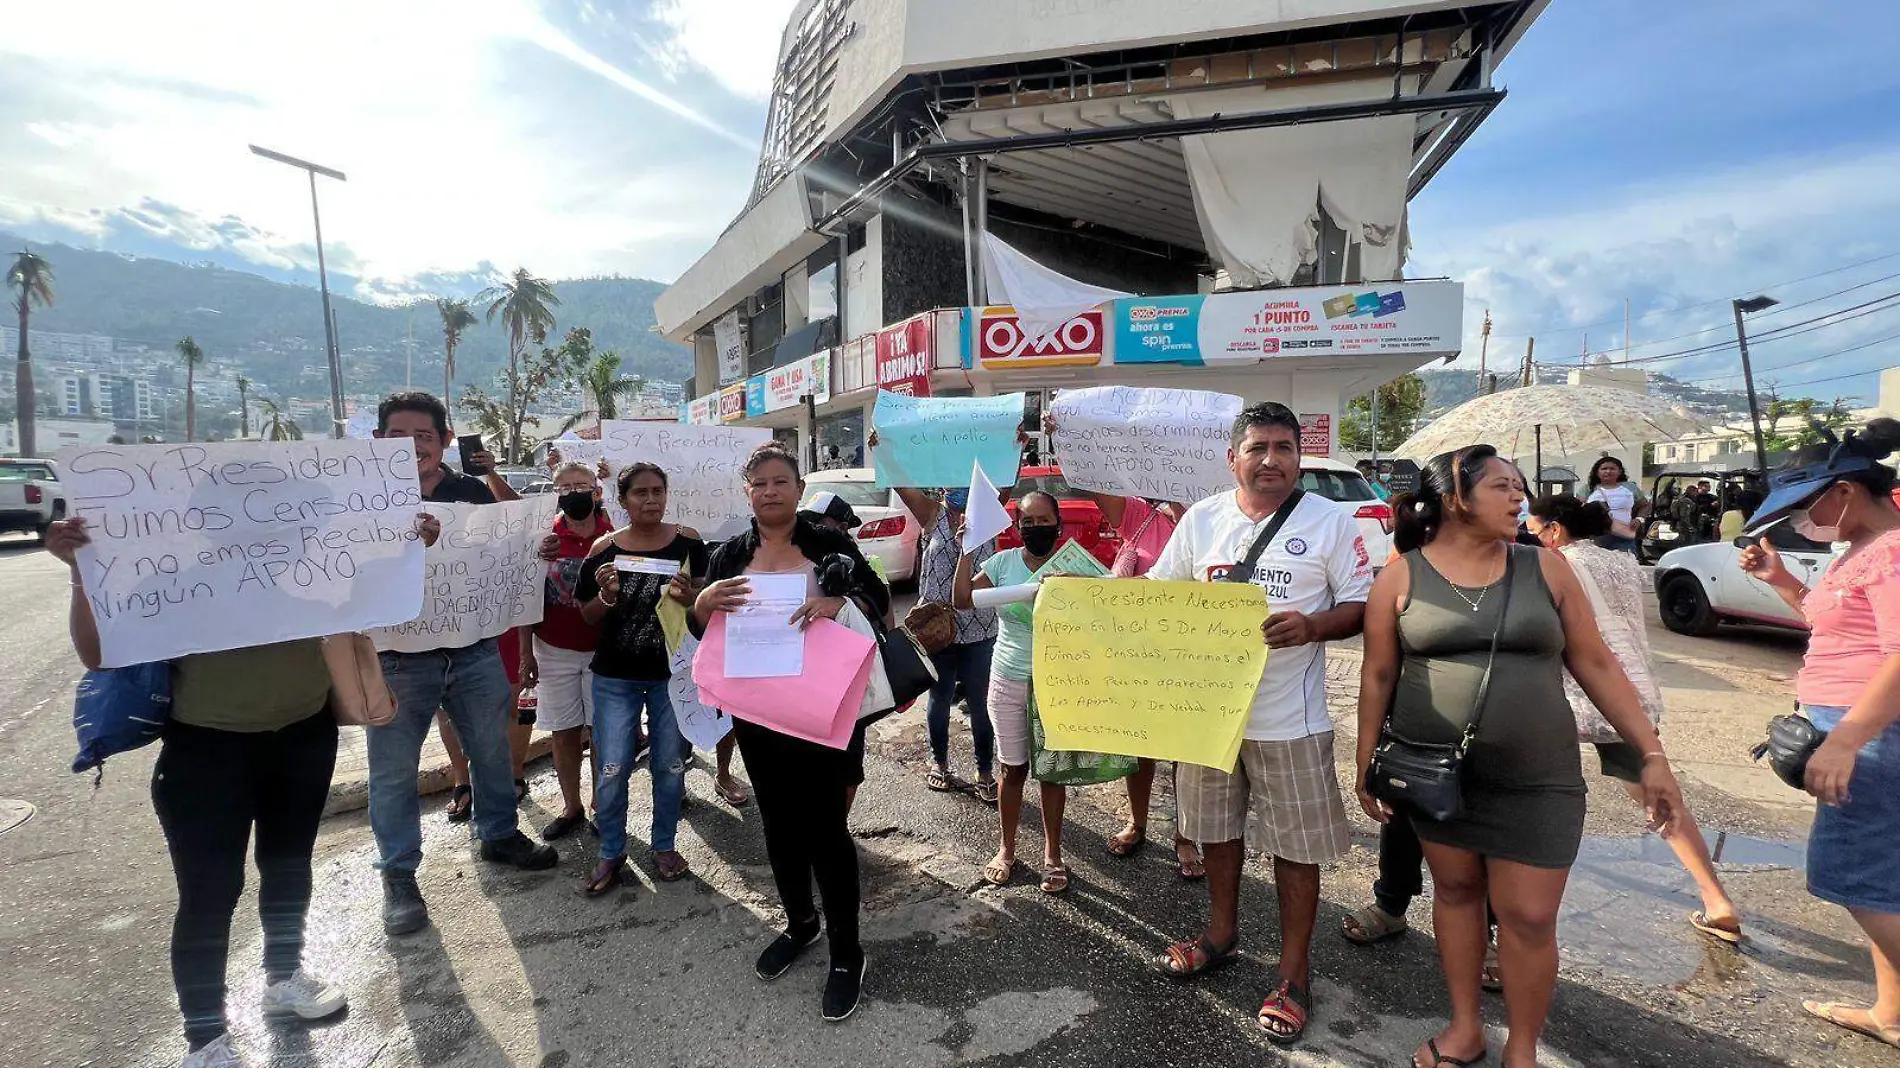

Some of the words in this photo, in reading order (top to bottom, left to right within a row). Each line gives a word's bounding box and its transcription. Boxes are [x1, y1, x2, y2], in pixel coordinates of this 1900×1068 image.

[1130, 322, 1160, 332] ahora
[1162, 323, 1175, 331] es
[1253, 313, 1260, 325] 1
[1265, 310, 1310, 325] PUNTO
[985, 316, 1095, 358] OXXO
[1142, 334, 1171, 347] spin
[880, 352, 926, 385] ABRIMOS!
[720, 391, 742, 412] OXXO
[1127, 422, 1231, 442] discriminada
[1300, 434, 1328, 446] OXXO
[165, 442, 416, 488] Presidente
[1104, 454, 1154, 472] APOYO
[75, 505, 234, 539] Fuimos
[243, 480, 421, 523] Censados
[134, 552, 179, 577] no
[196, 539, 292, 567] emos
[480, 550, 496, 573] 5
[90, 577, 214, 620] Ningún
[1086, 583, 1176, 608] Presidente
[1042, 620, 1083, 640] Apoyo
[1207, 620, 1253, 640] Mayo
[1043, 644, 1091, 663] Fuimos
[1157, 678, 1235, 691] aparecimos
[1056, 723, 1148, 741] necesitamos
